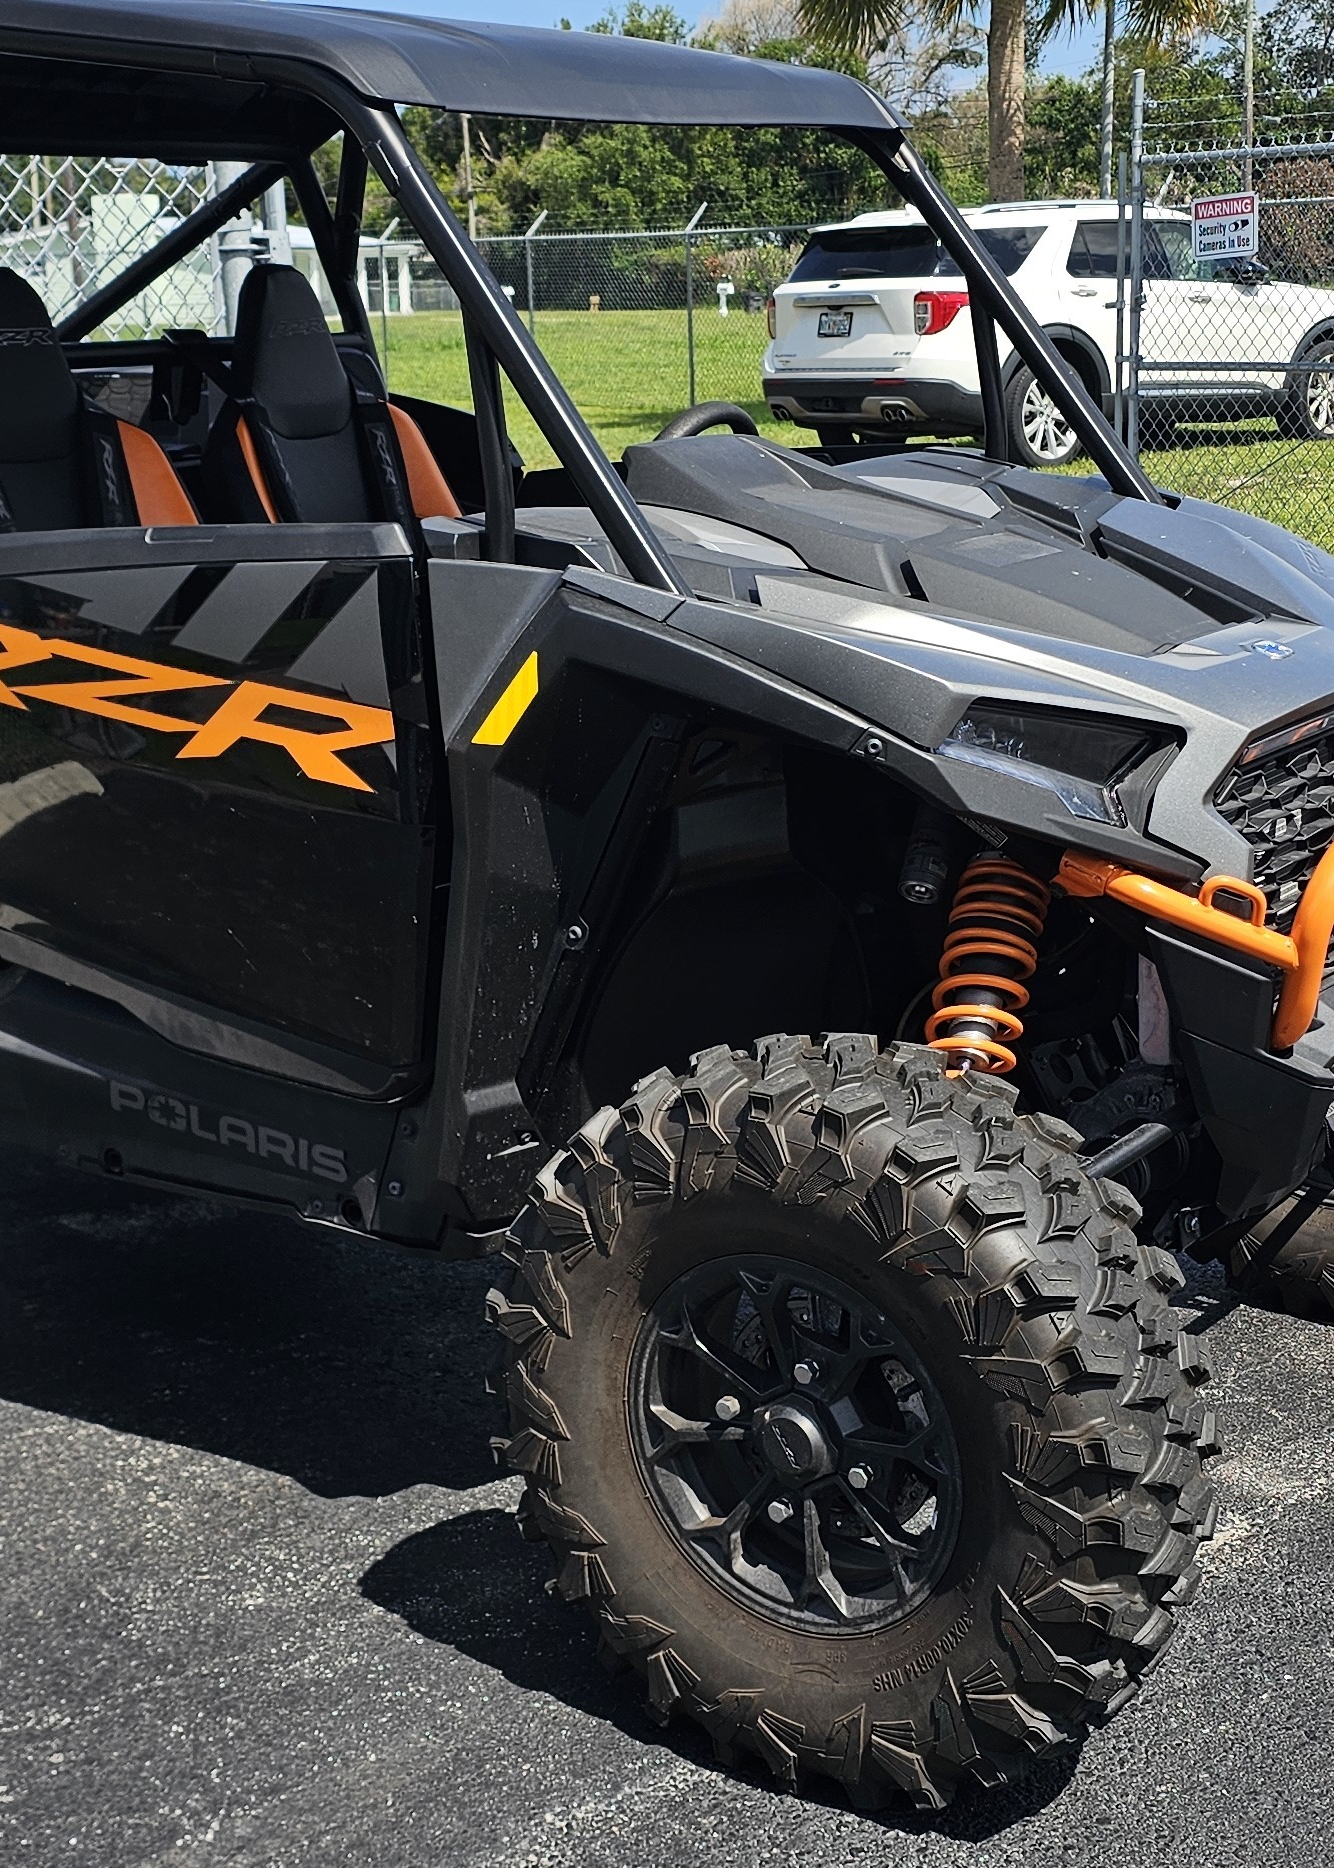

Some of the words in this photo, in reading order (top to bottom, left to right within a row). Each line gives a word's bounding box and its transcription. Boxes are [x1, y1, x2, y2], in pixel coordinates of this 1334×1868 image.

[1197, 199, 1252, 218] WARNING
[1198, 222, 1227, 238] Security
[1198, 240, 1227, 252] Cameras
[1228, 236, 1236, 248] In
[1237, 235, 1250, 247] Use
[109, 1079, 349, 1184] POLARIS
[872, 1668, 905, 1692] NHS
